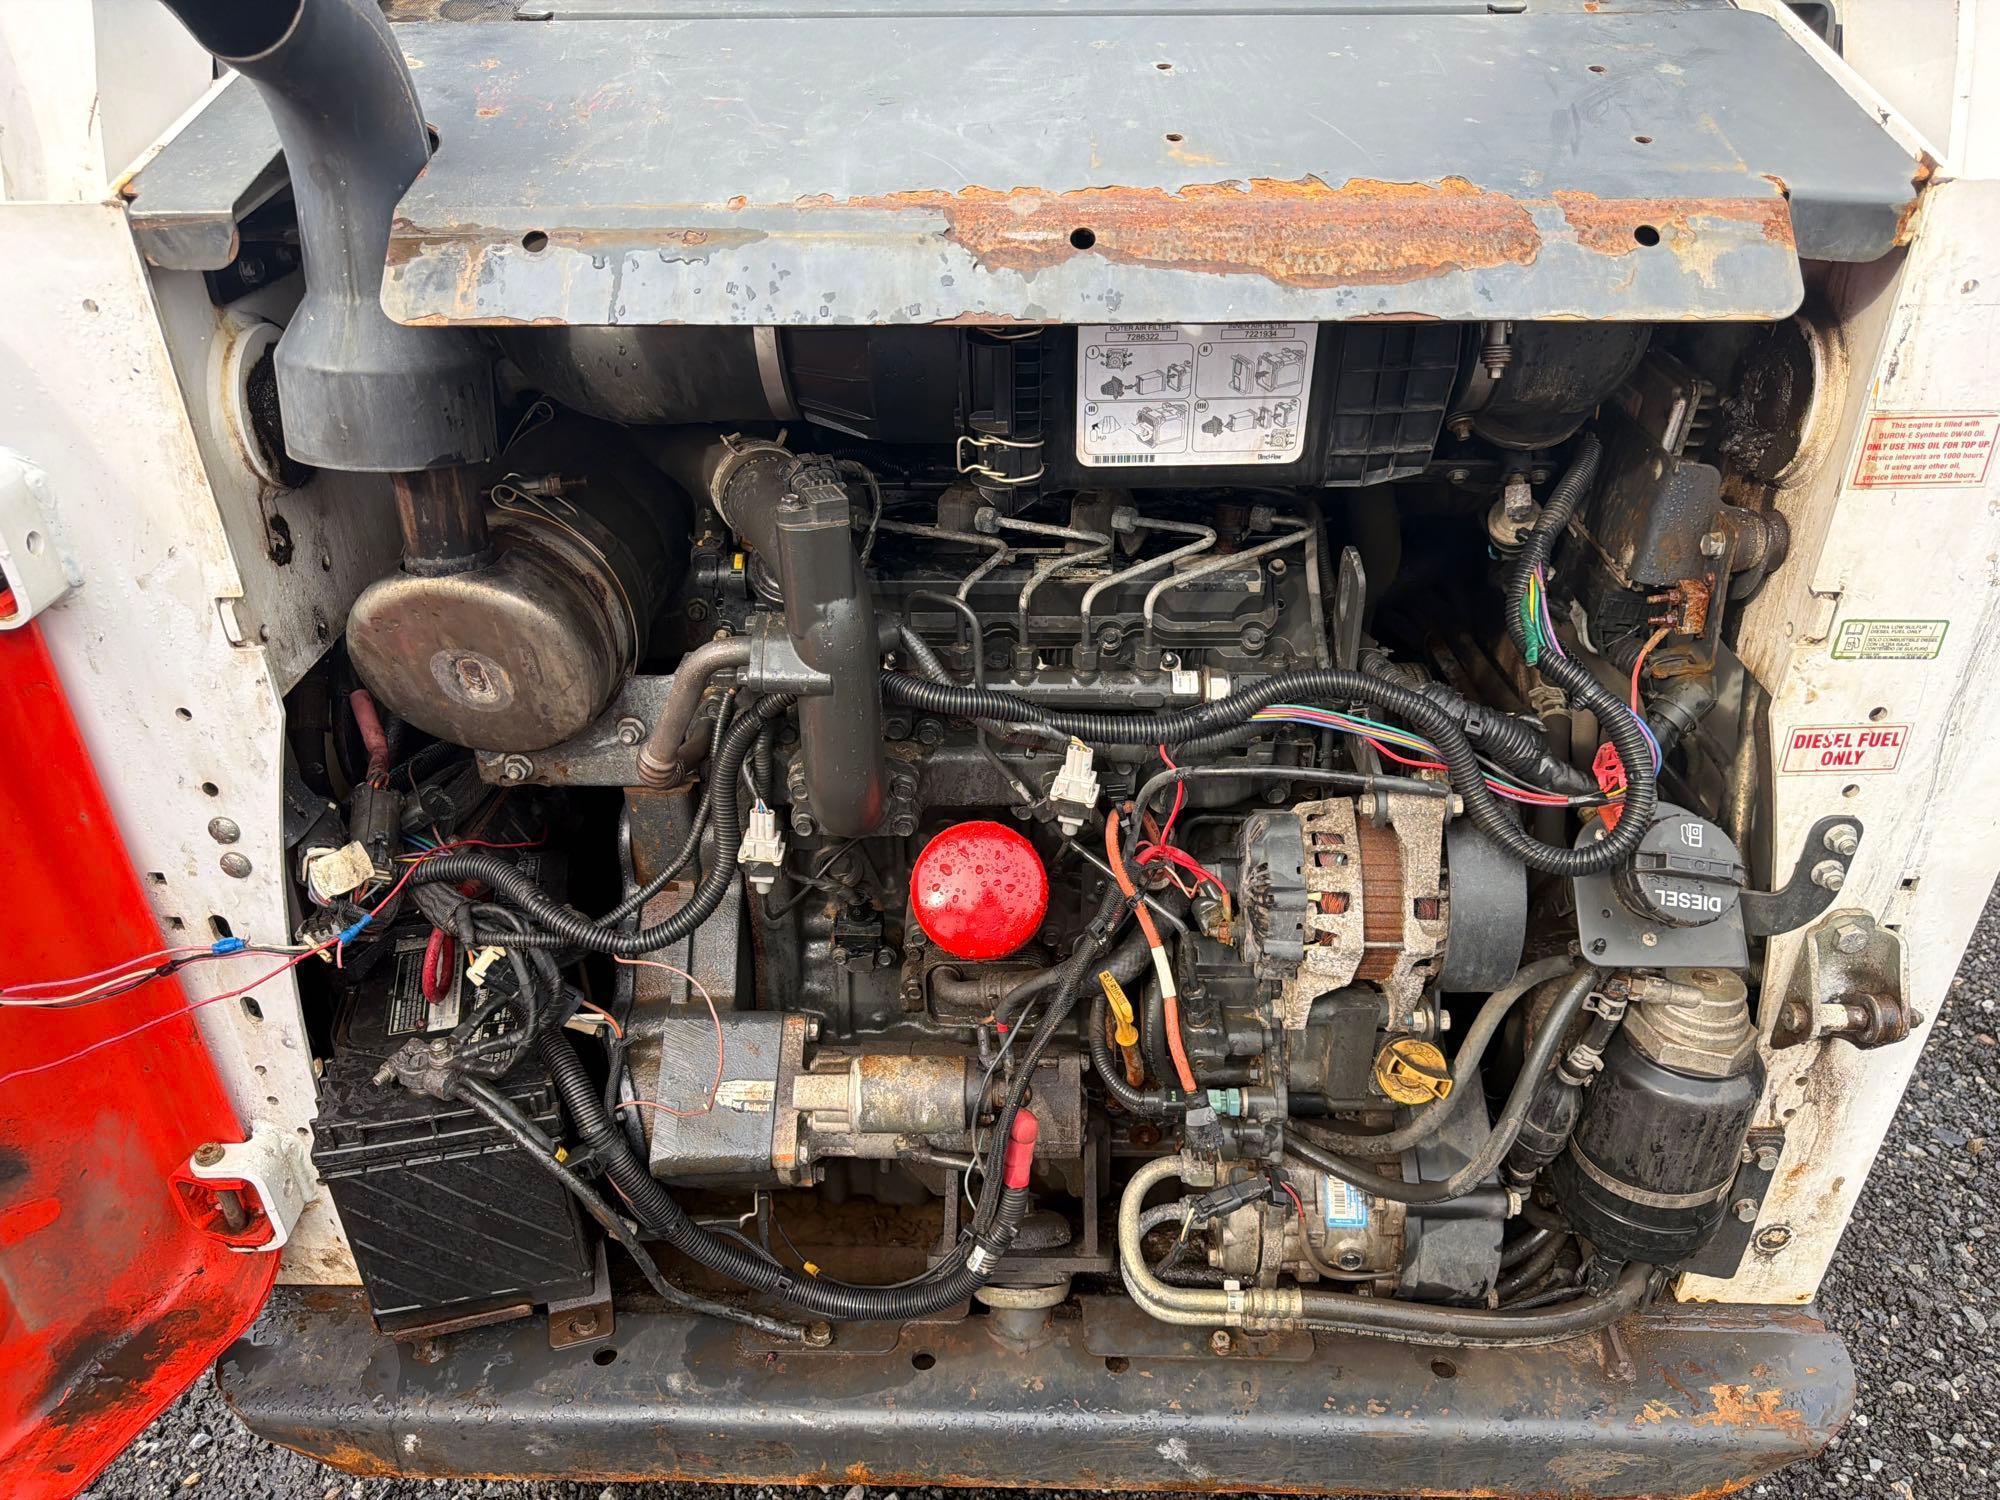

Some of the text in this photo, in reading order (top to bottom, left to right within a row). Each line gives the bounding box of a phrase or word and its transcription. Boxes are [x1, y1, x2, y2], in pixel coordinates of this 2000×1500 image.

[1915, 430, 1948, 439] Synthetic
[1793, 732, 1900, 749] DIESEL FUEL
[1820, 750, 1866, 766] ONLY
[1654, 890, 1722, 912] DIESEL
[744, 1102, 770, 1112] Bobcat
